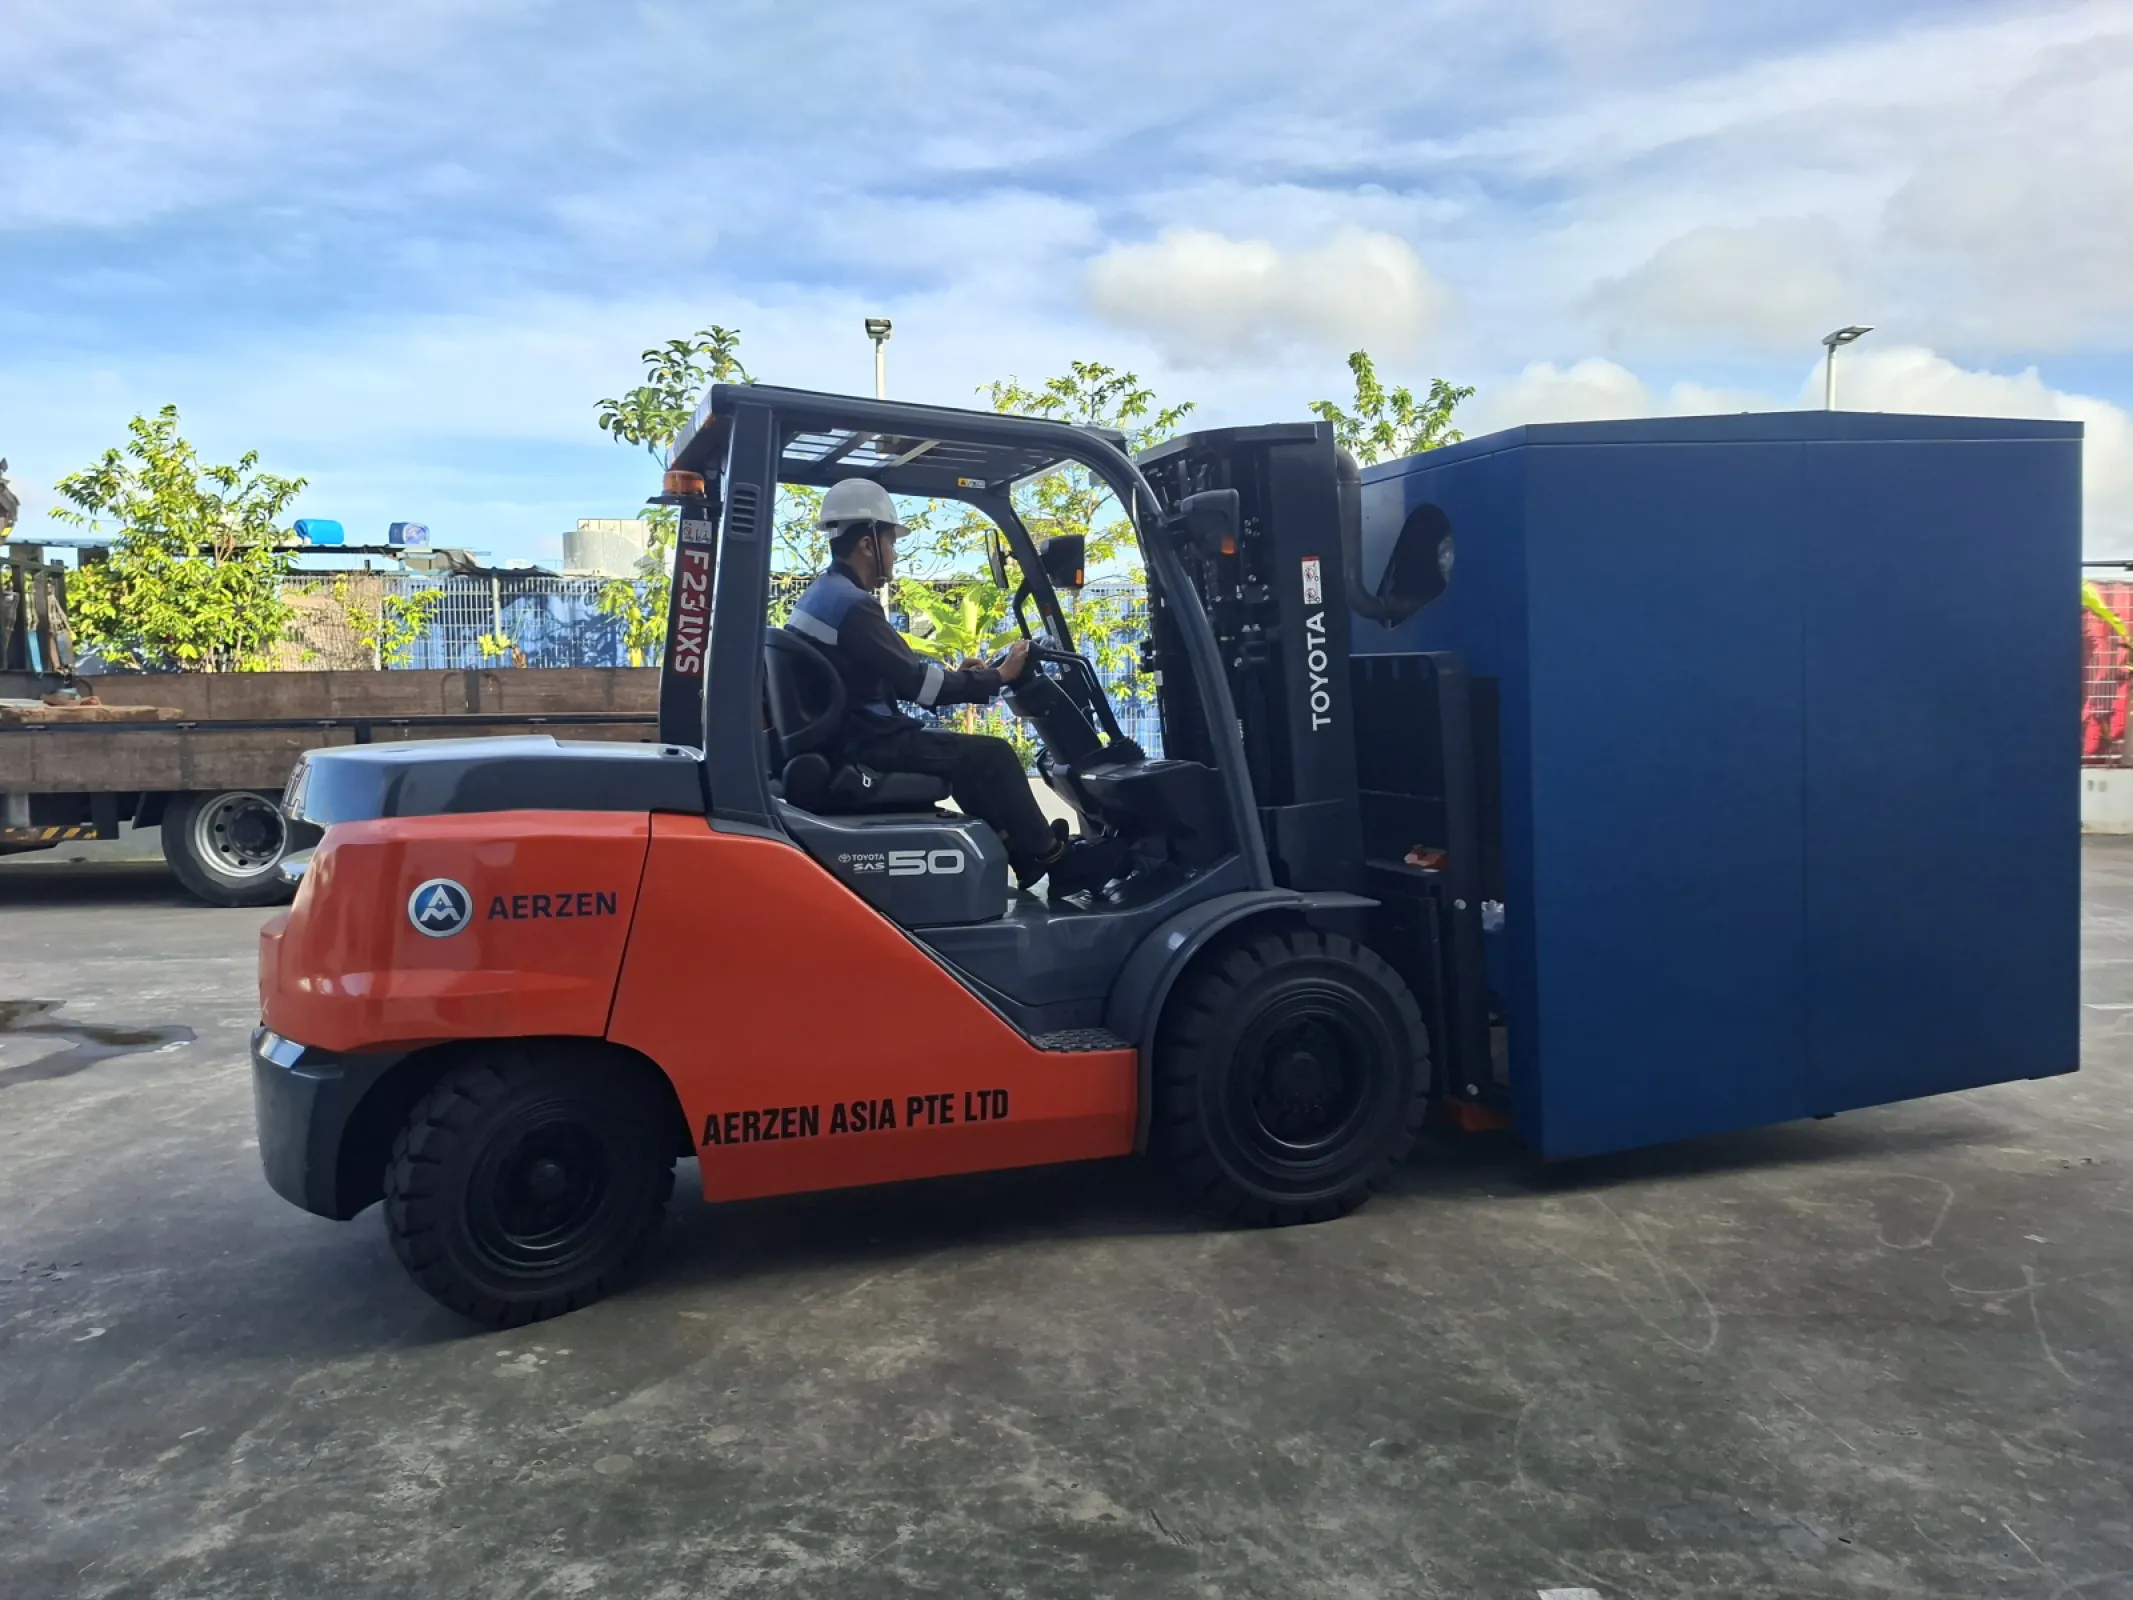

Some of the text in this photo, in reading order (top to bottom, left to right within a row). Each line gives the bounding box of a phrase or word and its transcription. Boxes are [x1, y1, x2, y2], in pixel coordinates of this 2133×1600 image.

[1306, 611, 1332, 731] TOYOTA
[852, 853, 885, 861] TOYOTA
[853, 862, 885, 871] SAS
[888, 849, 965, 876] 50
[487, 891, 617, 920] AERZEN
[702, 1089, 1009, 1147] AERZEN ASIA PTE LTD
